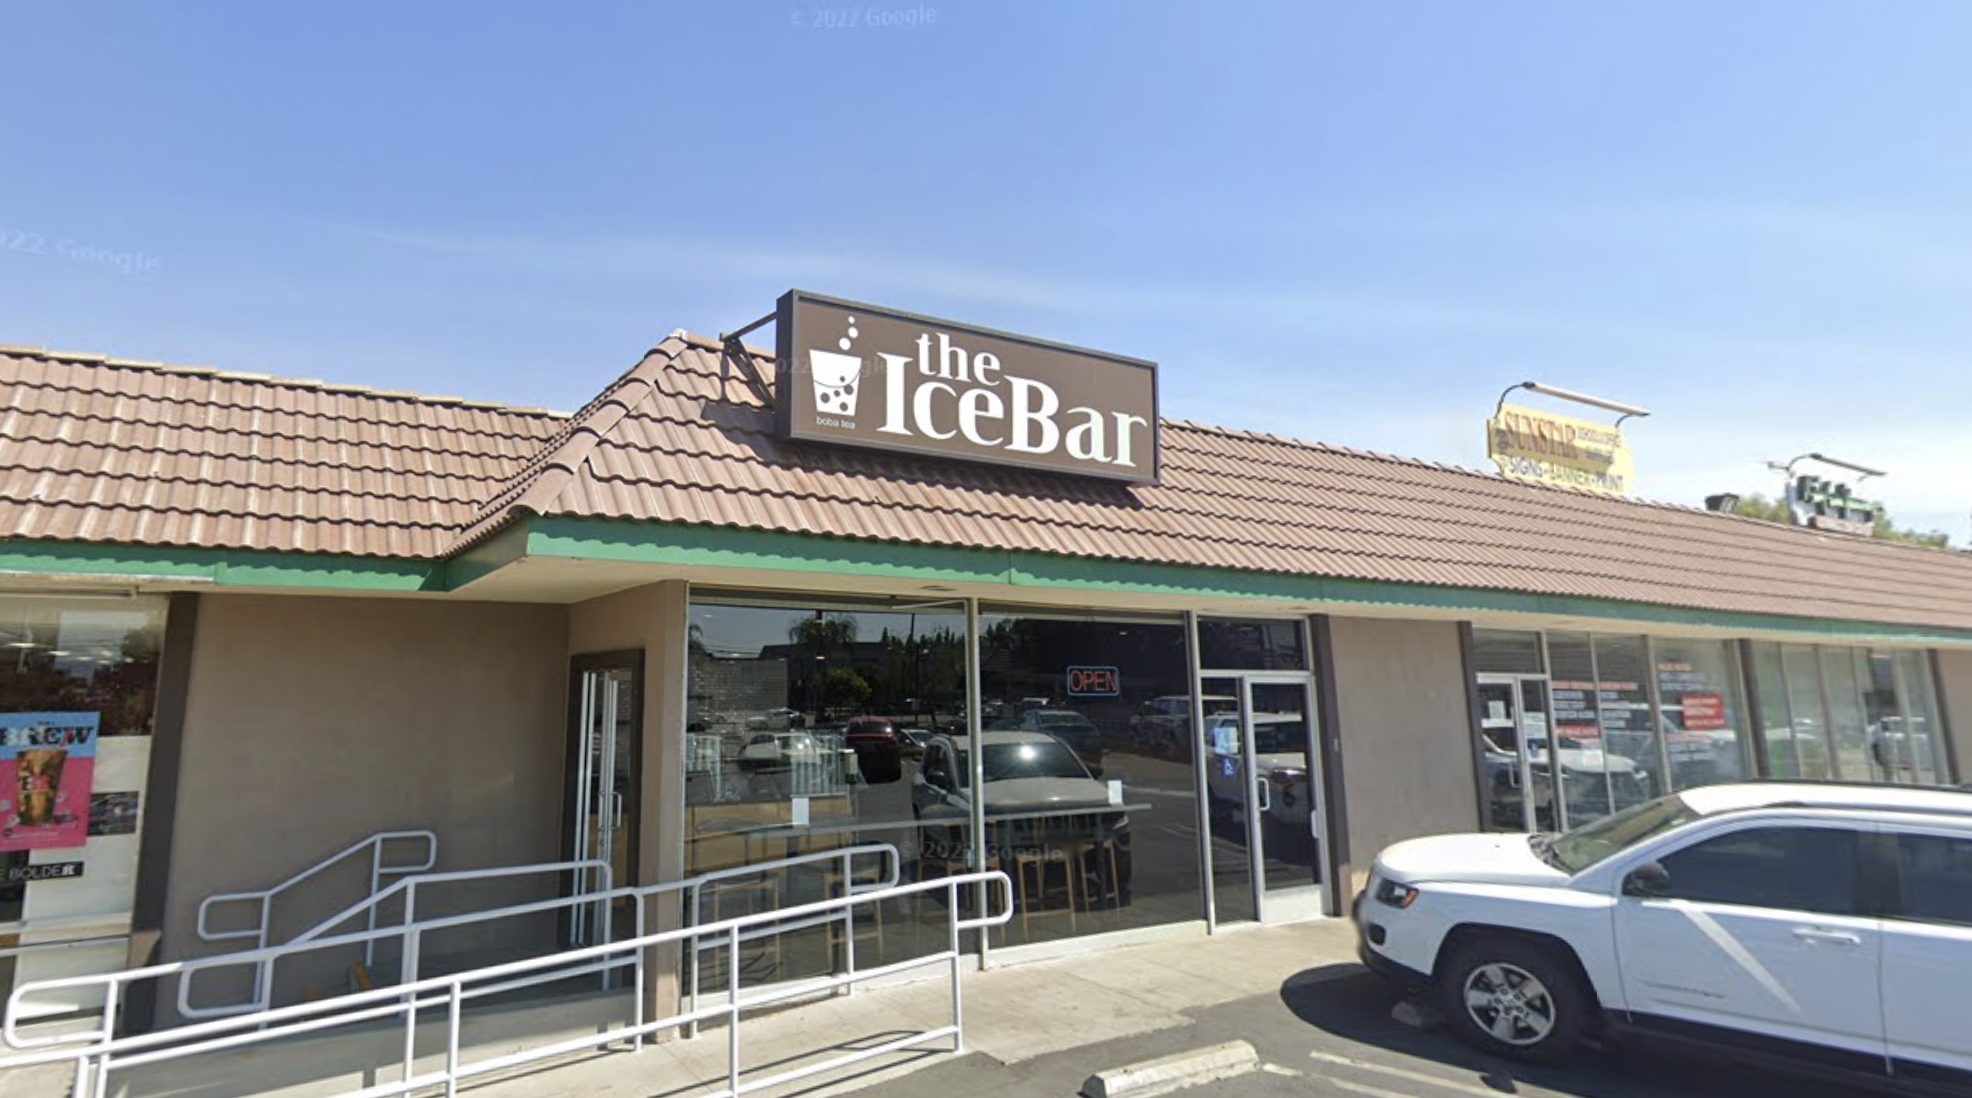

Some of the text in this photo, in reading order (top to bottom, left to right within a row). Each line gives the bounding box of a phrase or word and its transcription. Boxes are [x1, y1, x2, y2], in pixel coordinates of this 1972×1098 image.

[914, 331, 1001, 387] the
[816, 416, 856, 430] boba tea
[876, 351, 1148, 468] IceBar
[1070, 670, 1117, 692] OPEN
